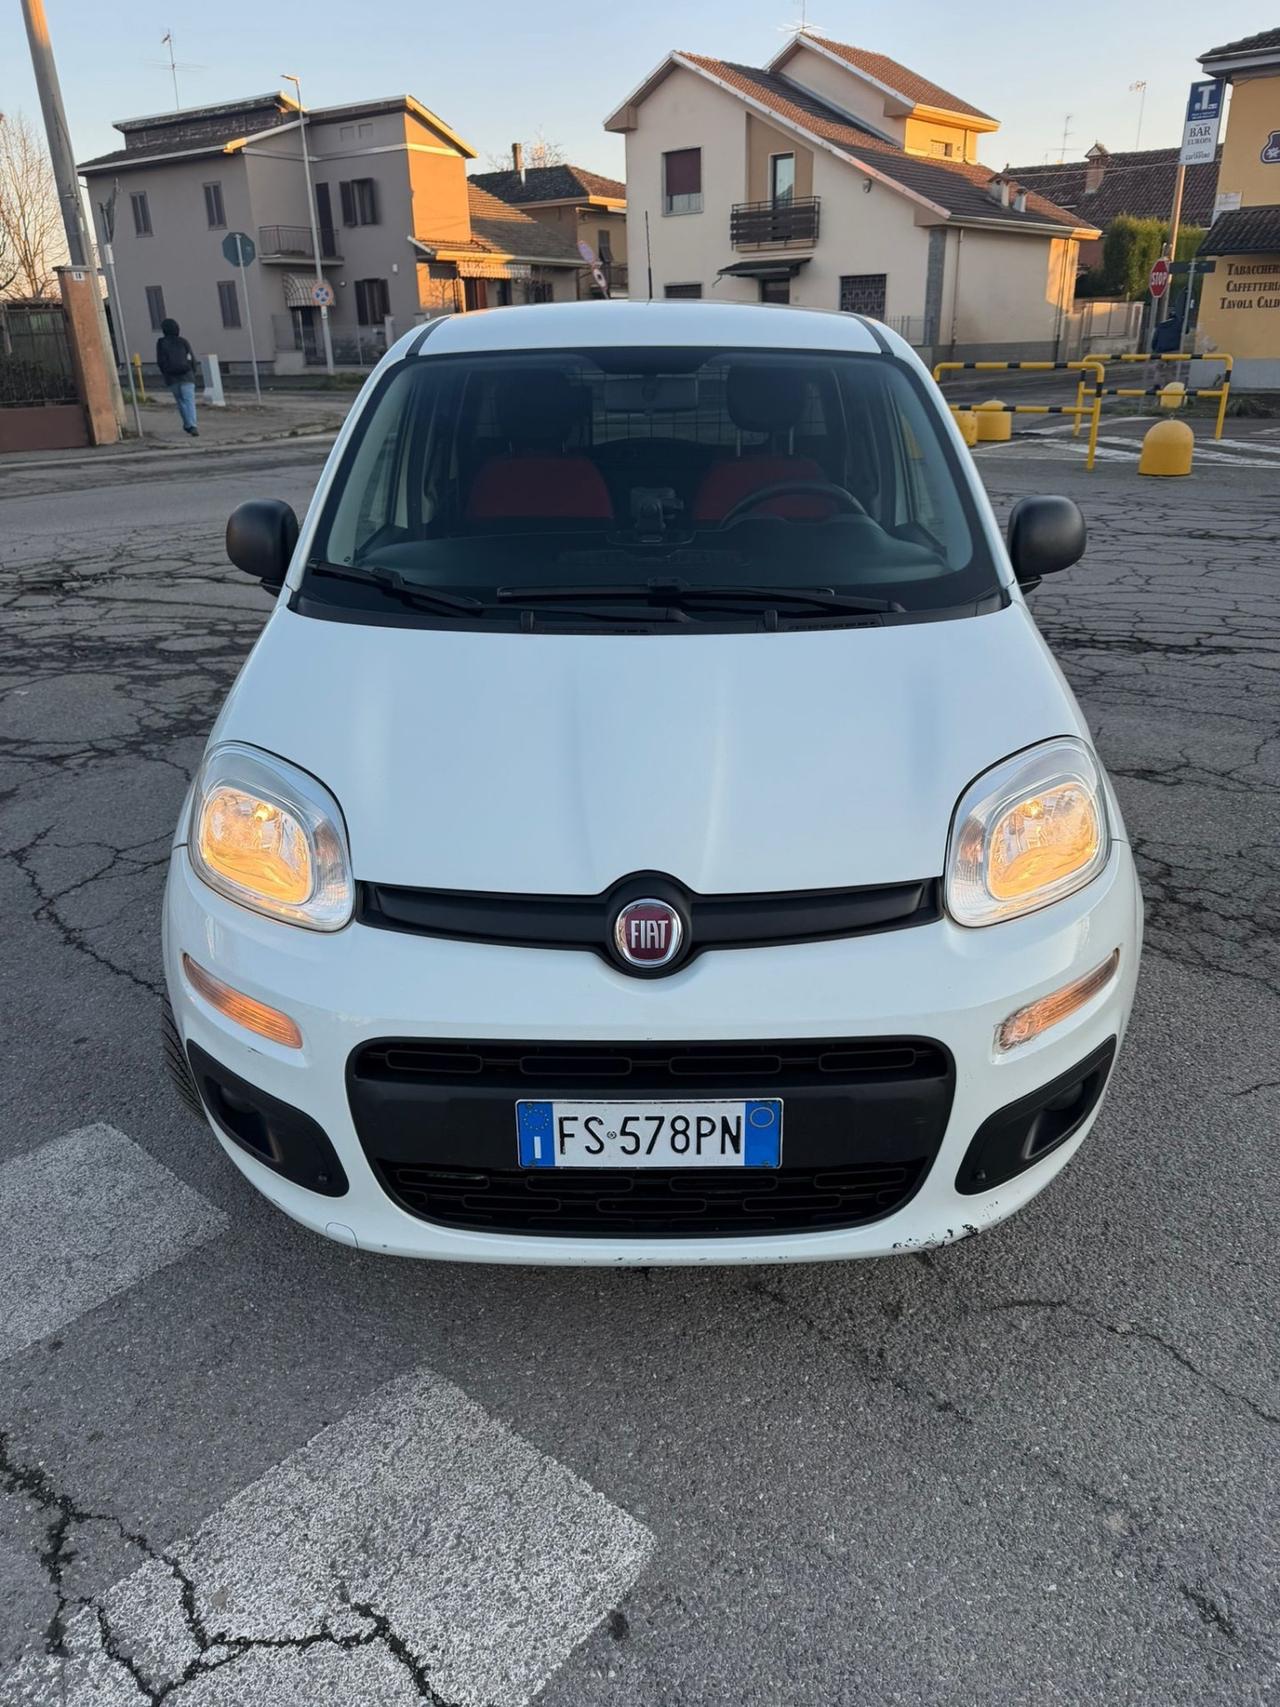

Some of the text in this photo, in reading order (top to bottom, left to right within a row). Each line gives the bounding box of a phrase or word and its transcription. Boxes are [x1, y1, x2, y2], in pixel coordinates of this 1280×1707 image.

[1189, 126, 1211, 138] BAR
[1152, 271, 1168, 286] STOP
[1220, 297, 1253, 310] TAVOLA
[631, 919, 669, 949] FIAT
